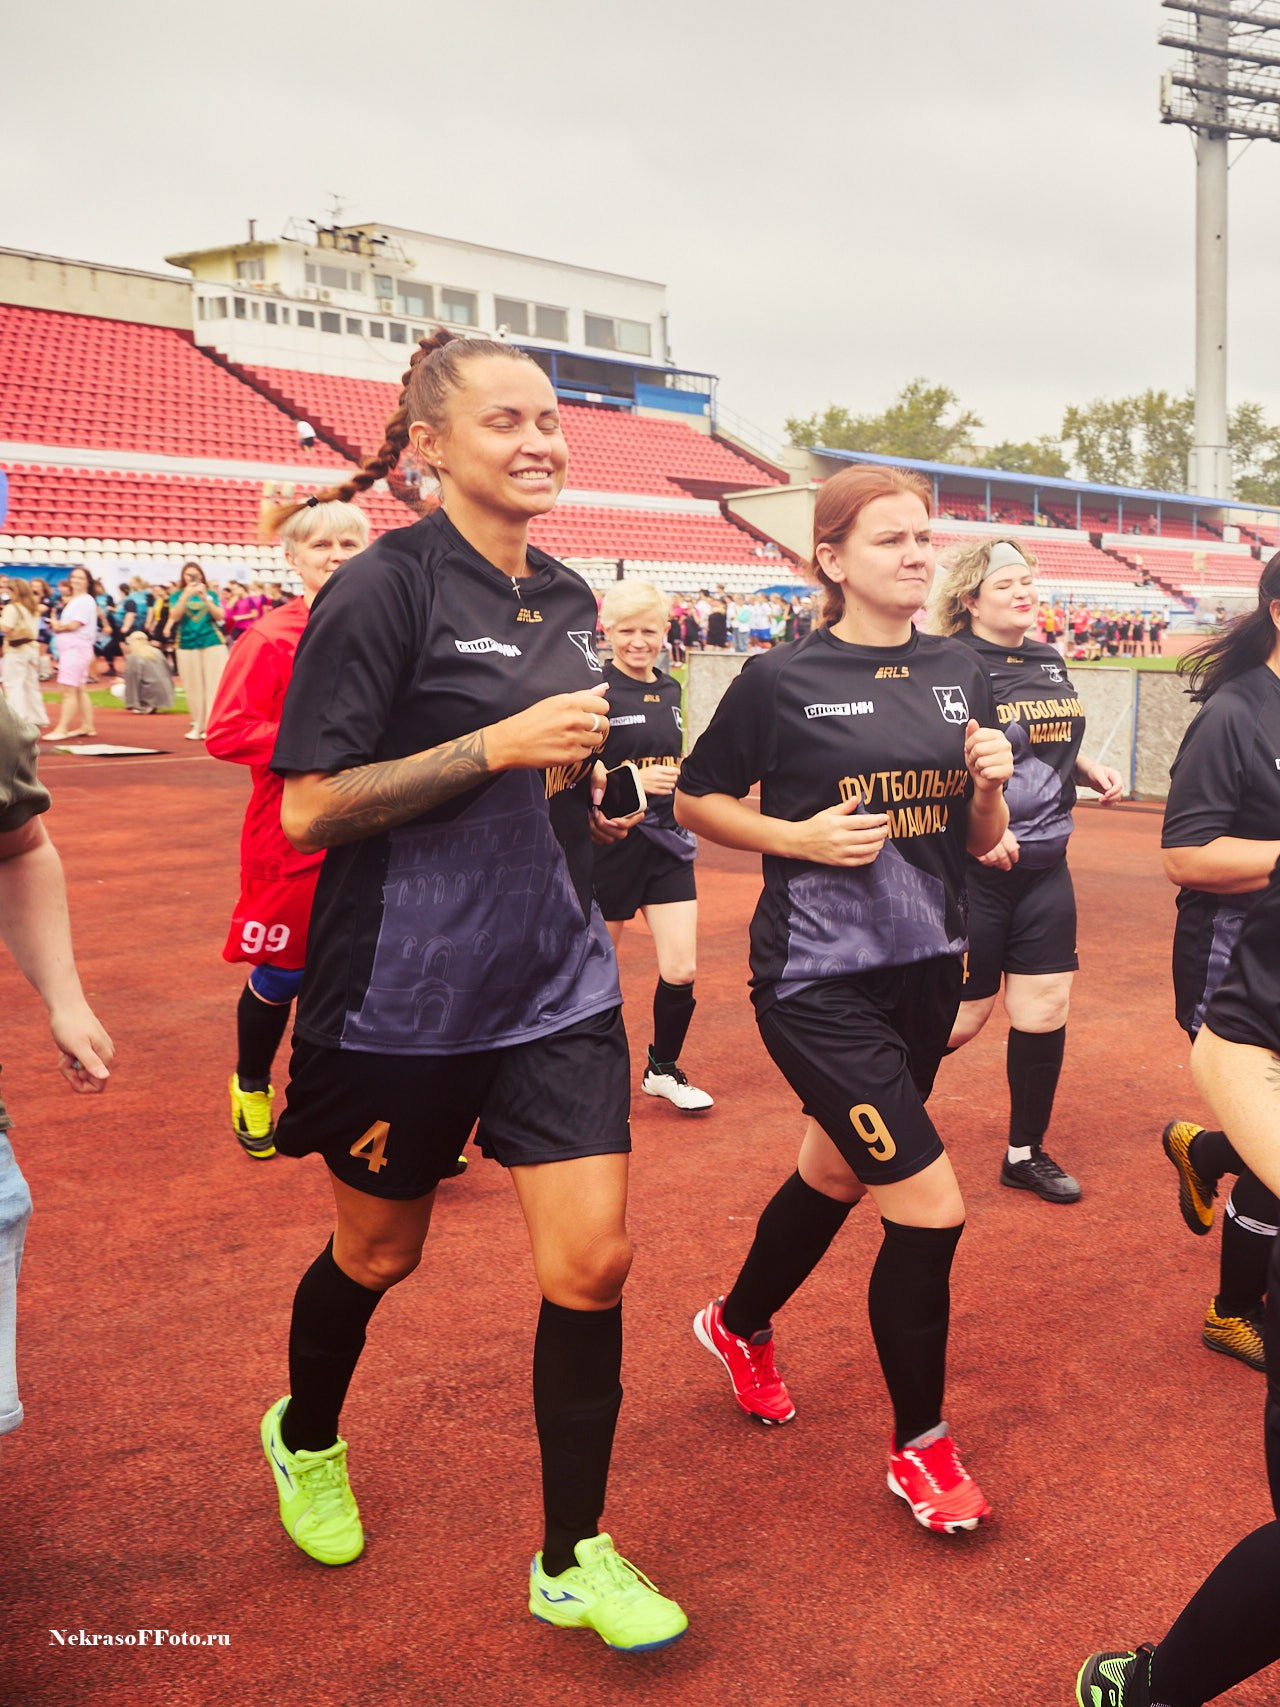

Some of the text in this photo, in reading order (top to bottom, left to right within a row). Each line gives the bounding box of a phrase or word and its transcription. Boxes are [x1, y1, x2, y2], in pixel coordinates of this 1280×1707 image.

[805, 703, 850, 718] СПОРТ
[1029, 721, 1072, 744] МАМА!
[241, 921, 291, 953] 99
[350, 1120, 391, 1173] 4
[849, 1103, 897, 1162] 9
